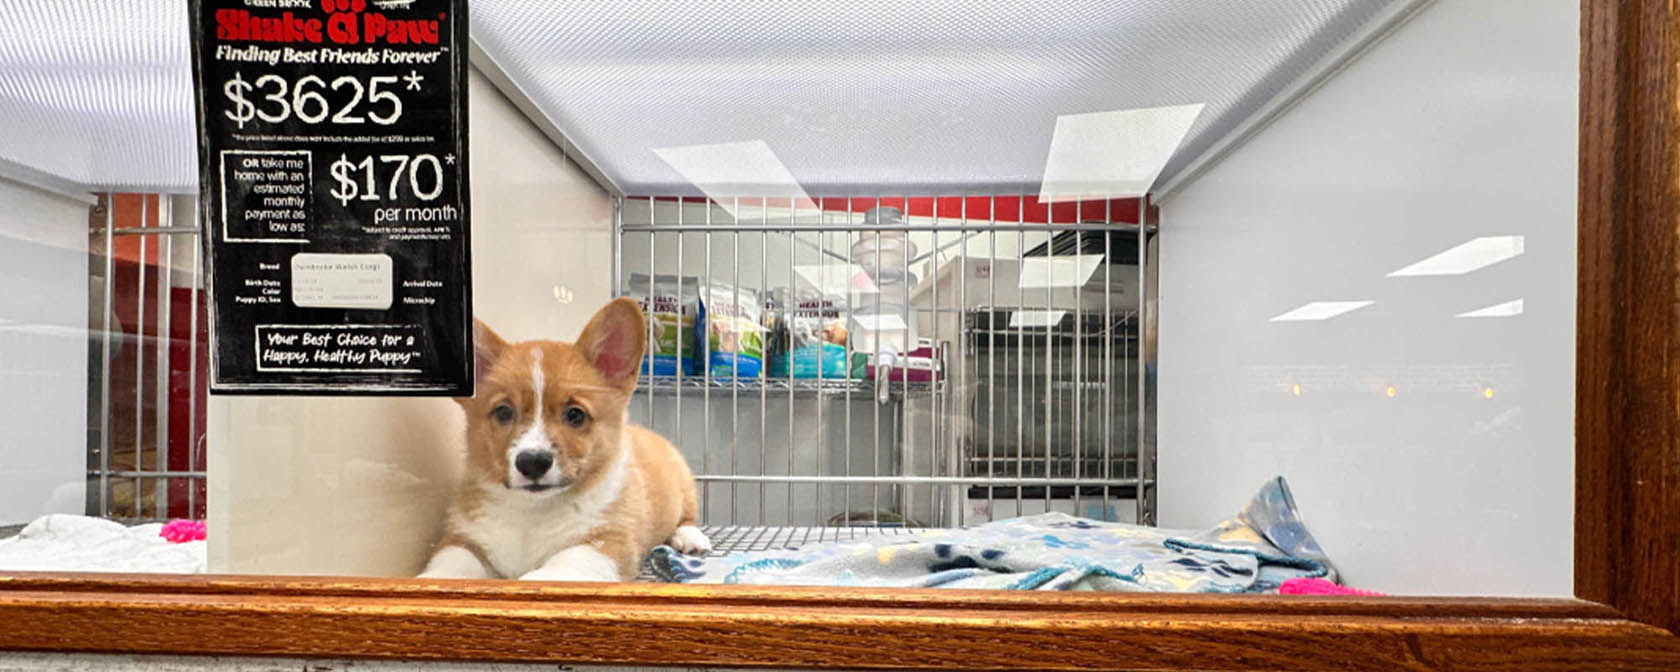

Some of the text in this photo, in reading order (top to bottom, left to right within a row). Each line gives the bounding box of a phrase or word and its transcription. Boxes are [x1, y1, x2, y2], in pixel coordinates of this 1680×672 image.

[216, 8, 323, 43] Shake
[216, 44, 281, 66] Finding
[283, 47, 318, 64] Best
[320, 48, 380, 64] Friends
[243, 157, 304, 169] OR take me
[234, 169, 304, 181] home with an
[253, 182, 305, 194] estimated
[264, 196, 305, 208] monthly
[245, 209, 306, 221] payment as
[374, 204, 457, 224] per month
[269, 220, 288, 232] low
[259, 262, 280, 270] Breed
[235, 296, 257, 304] Puppy
[267, 332, 415, 347] Your Best Choice for a
[314, 349, 366, 364] Healthy
